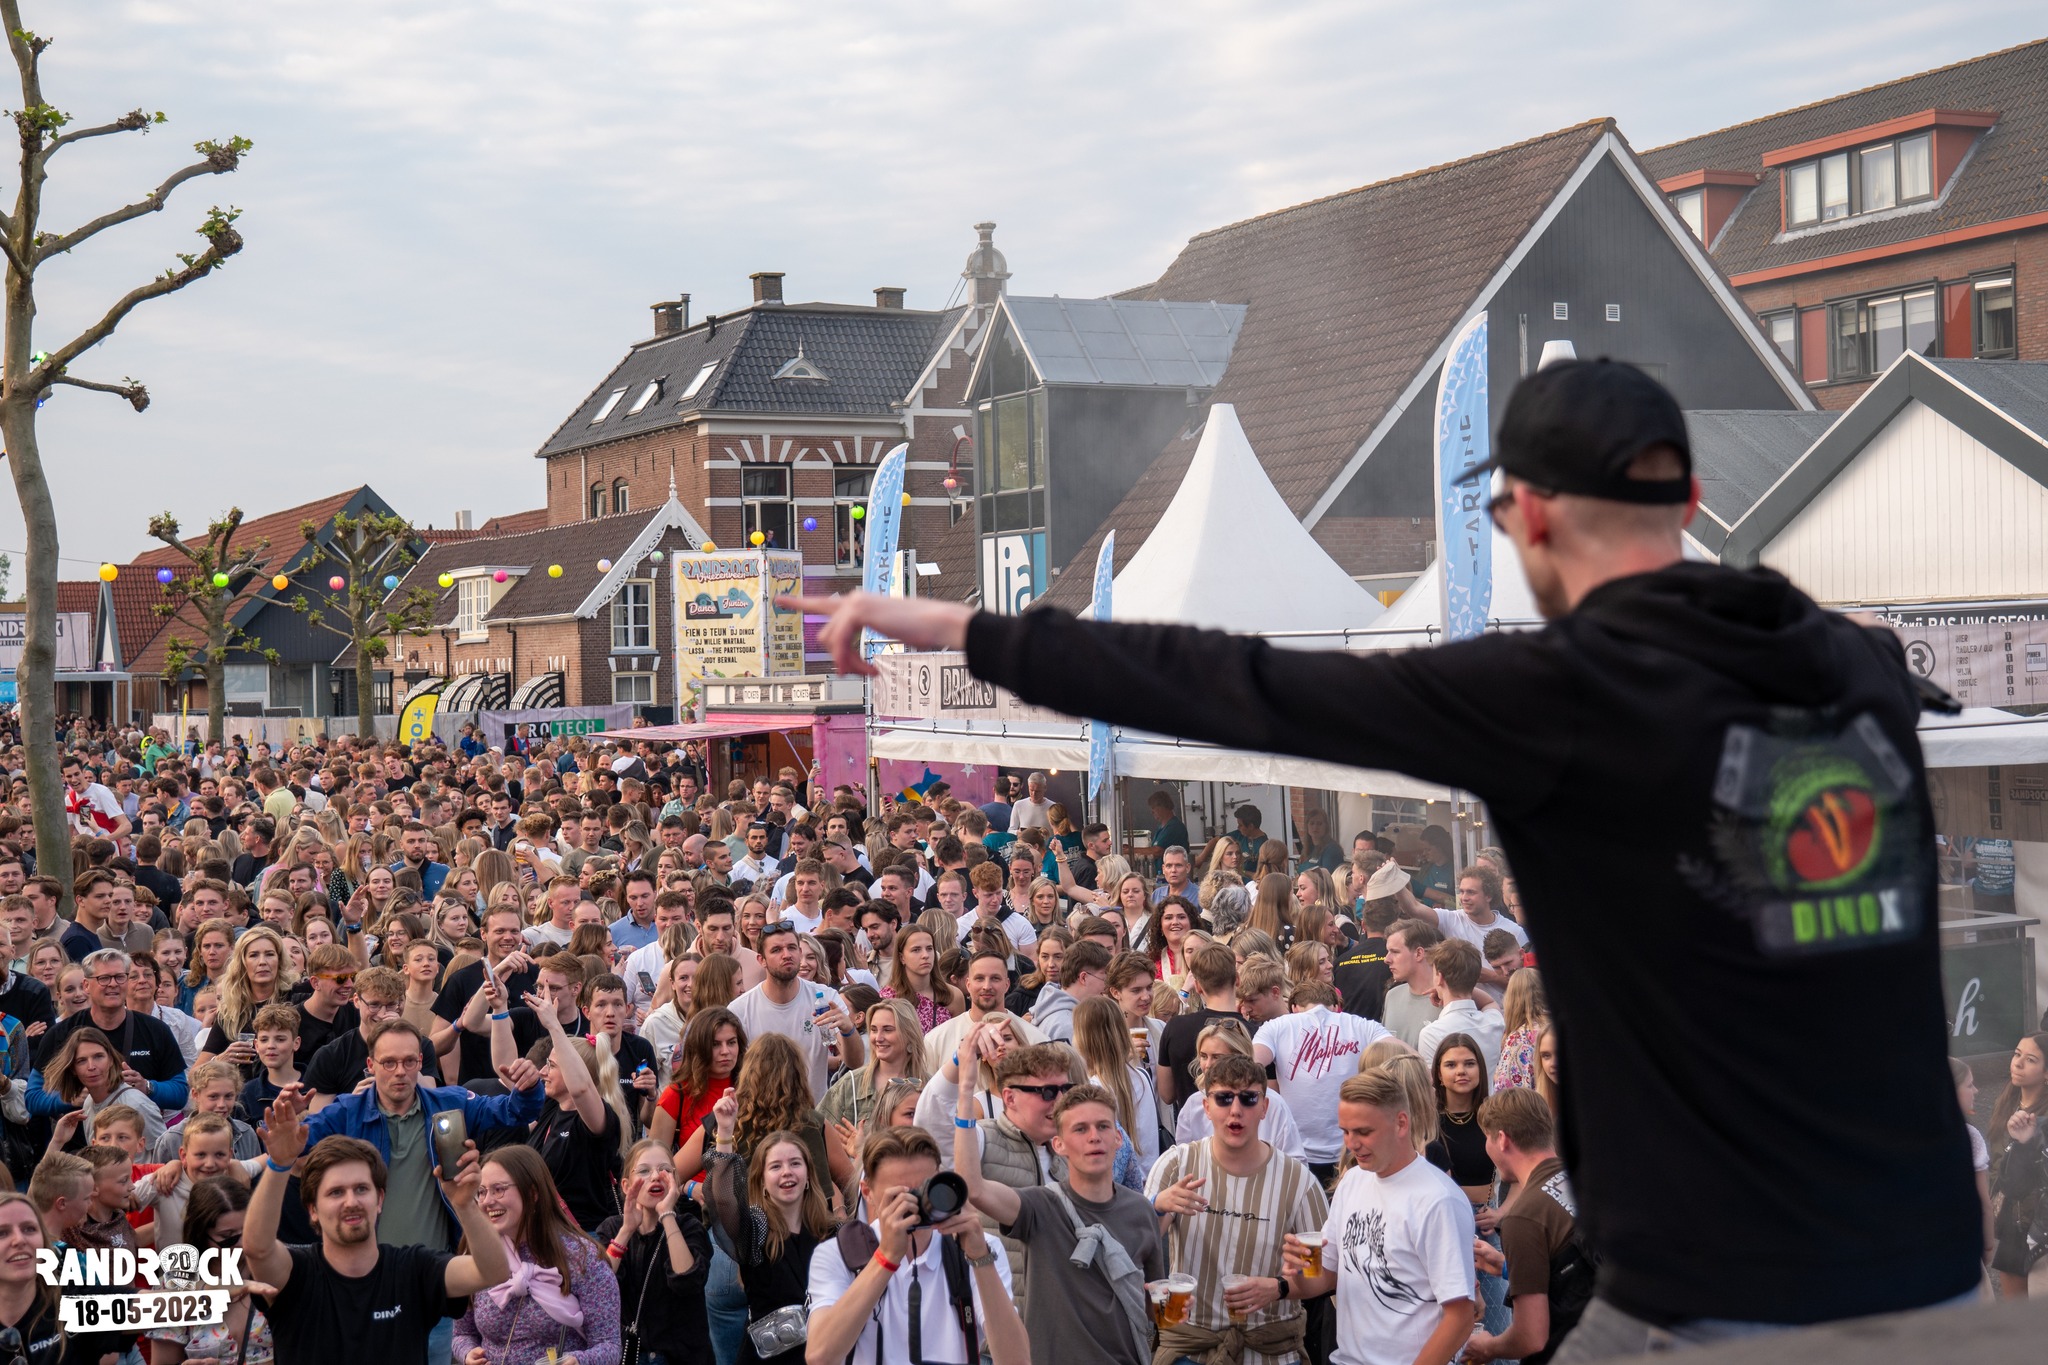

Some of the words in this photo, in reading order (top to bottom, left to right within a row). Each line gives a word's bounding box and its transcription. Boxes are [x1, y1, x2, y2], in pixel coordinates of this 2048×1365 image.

[681, 559, 760, 580] RANDROCK
[689, 603, 717, 616] Dance
[723, 598, 749, 609] Junior
[685, 628, 700, 637] FIEN
[710, 628, 726, 636] TEUN
[739, 628, 755, 636] DINOX
[556, 720, 595, 735] TECH
[1792, 889, 1904, 943] DINOX
